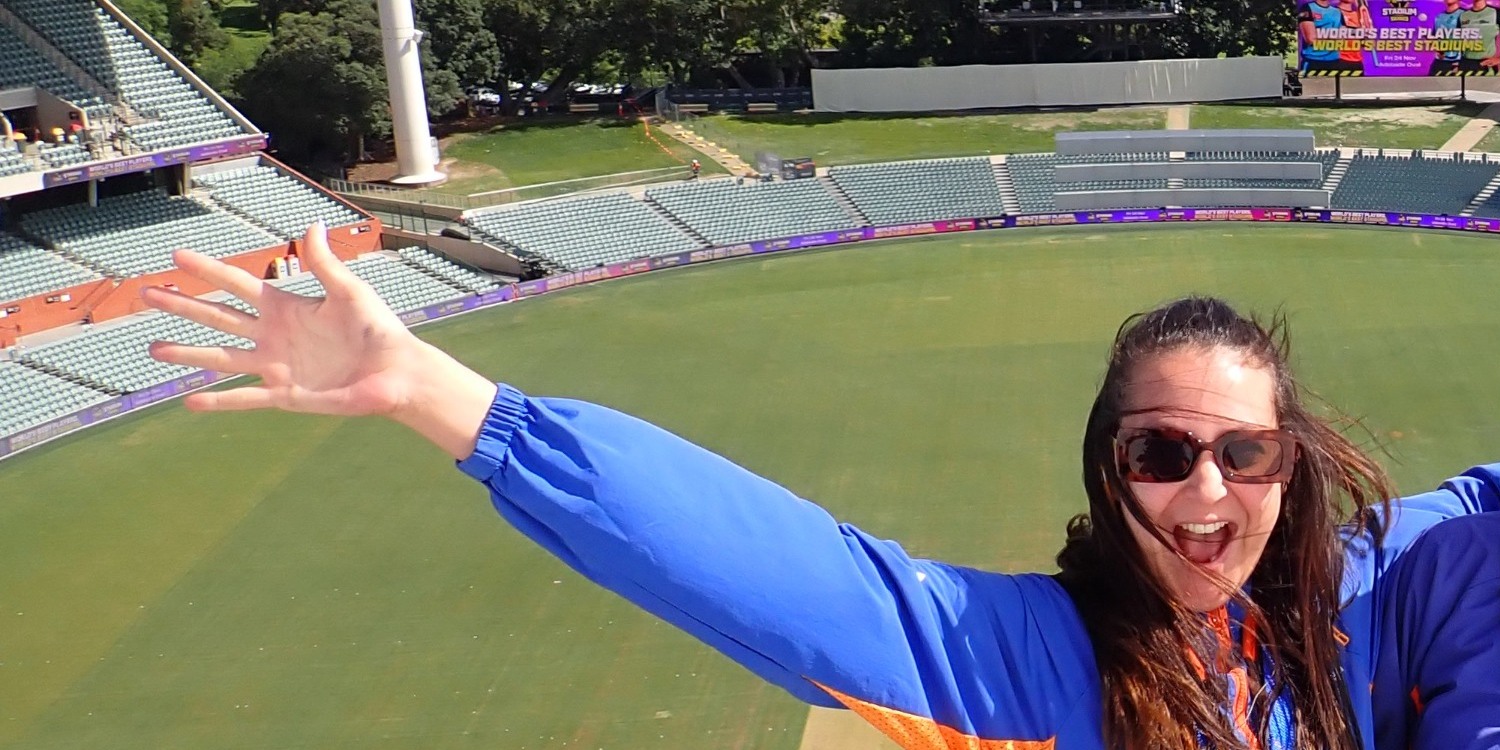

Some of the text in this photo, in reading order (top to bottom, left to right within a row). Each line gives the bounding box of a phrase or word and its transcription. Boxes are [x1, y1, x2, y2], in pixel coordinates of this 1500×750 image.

[1382, 8, 1417, 16] STADIUM
[1316, 28, 1482, 39] WORLD'S BEST PLAYERS.
[1313, 40, 1374, 51] WORLD'S
[1377, 40, 1411, 51] BEST
